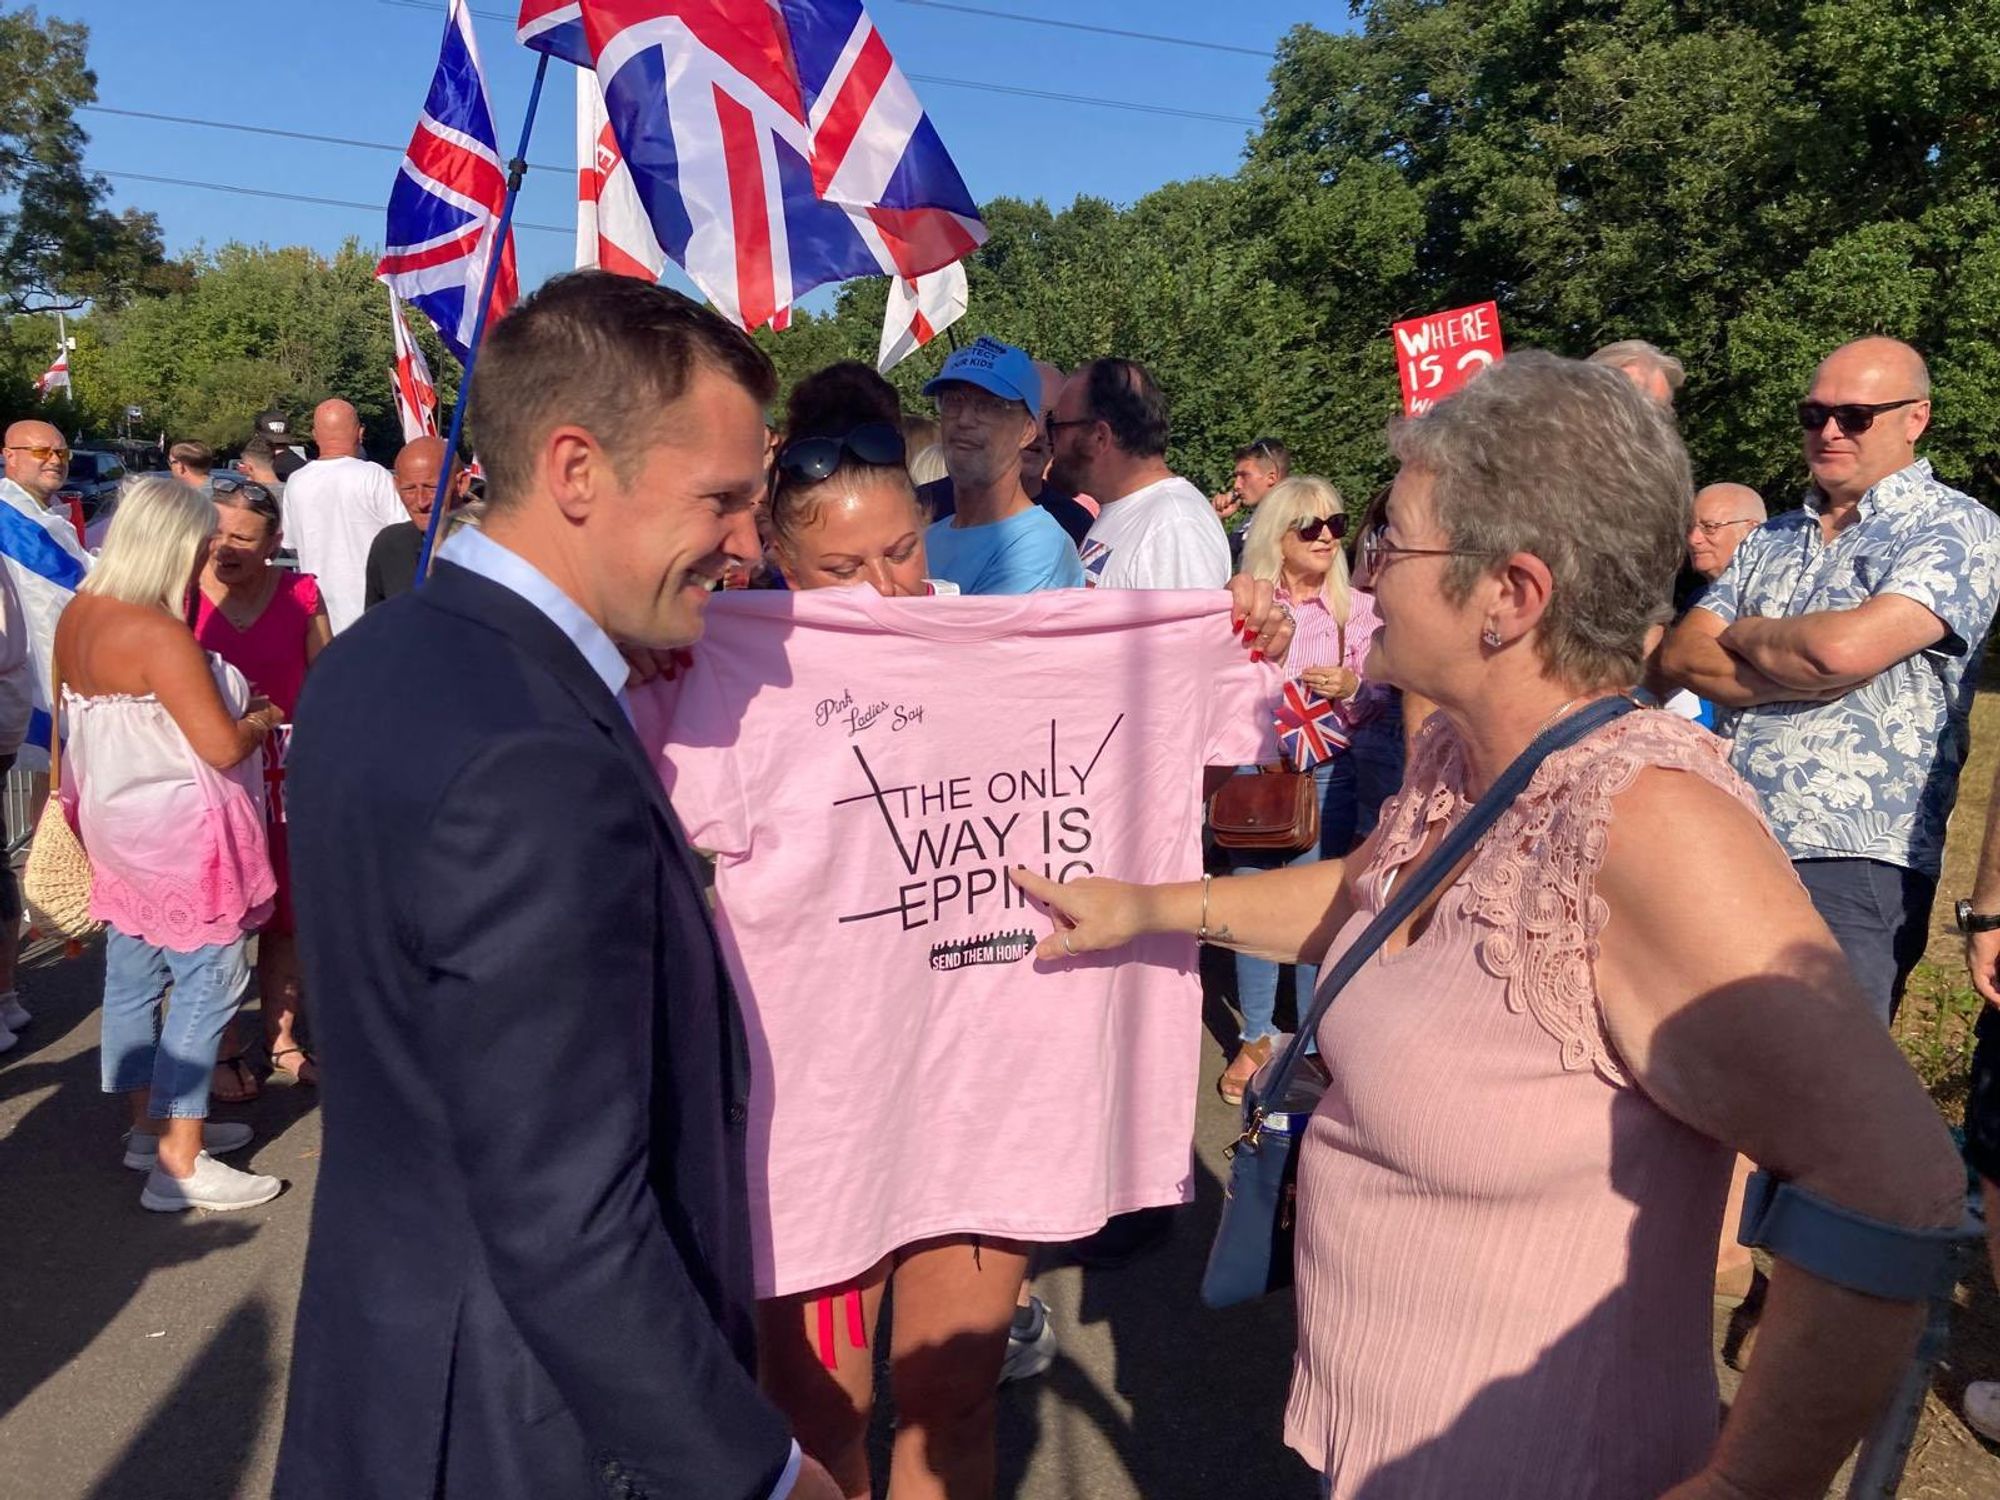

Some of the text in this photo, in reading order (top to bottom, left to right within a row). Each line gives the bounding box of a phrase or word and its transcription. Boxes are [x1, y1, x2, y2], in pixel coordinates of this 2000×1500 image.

[1397, 307, 1492, 357] WHERE
[1408, 354, 1444, 391] IS
[815, 688, 923, 737] Pink Ladies Say
[987, 713, 1124, 804] ONLY
[852, 745, 1092, 875] WAY IS
[932, 943, 1029, 970] SEND THEM HOME
